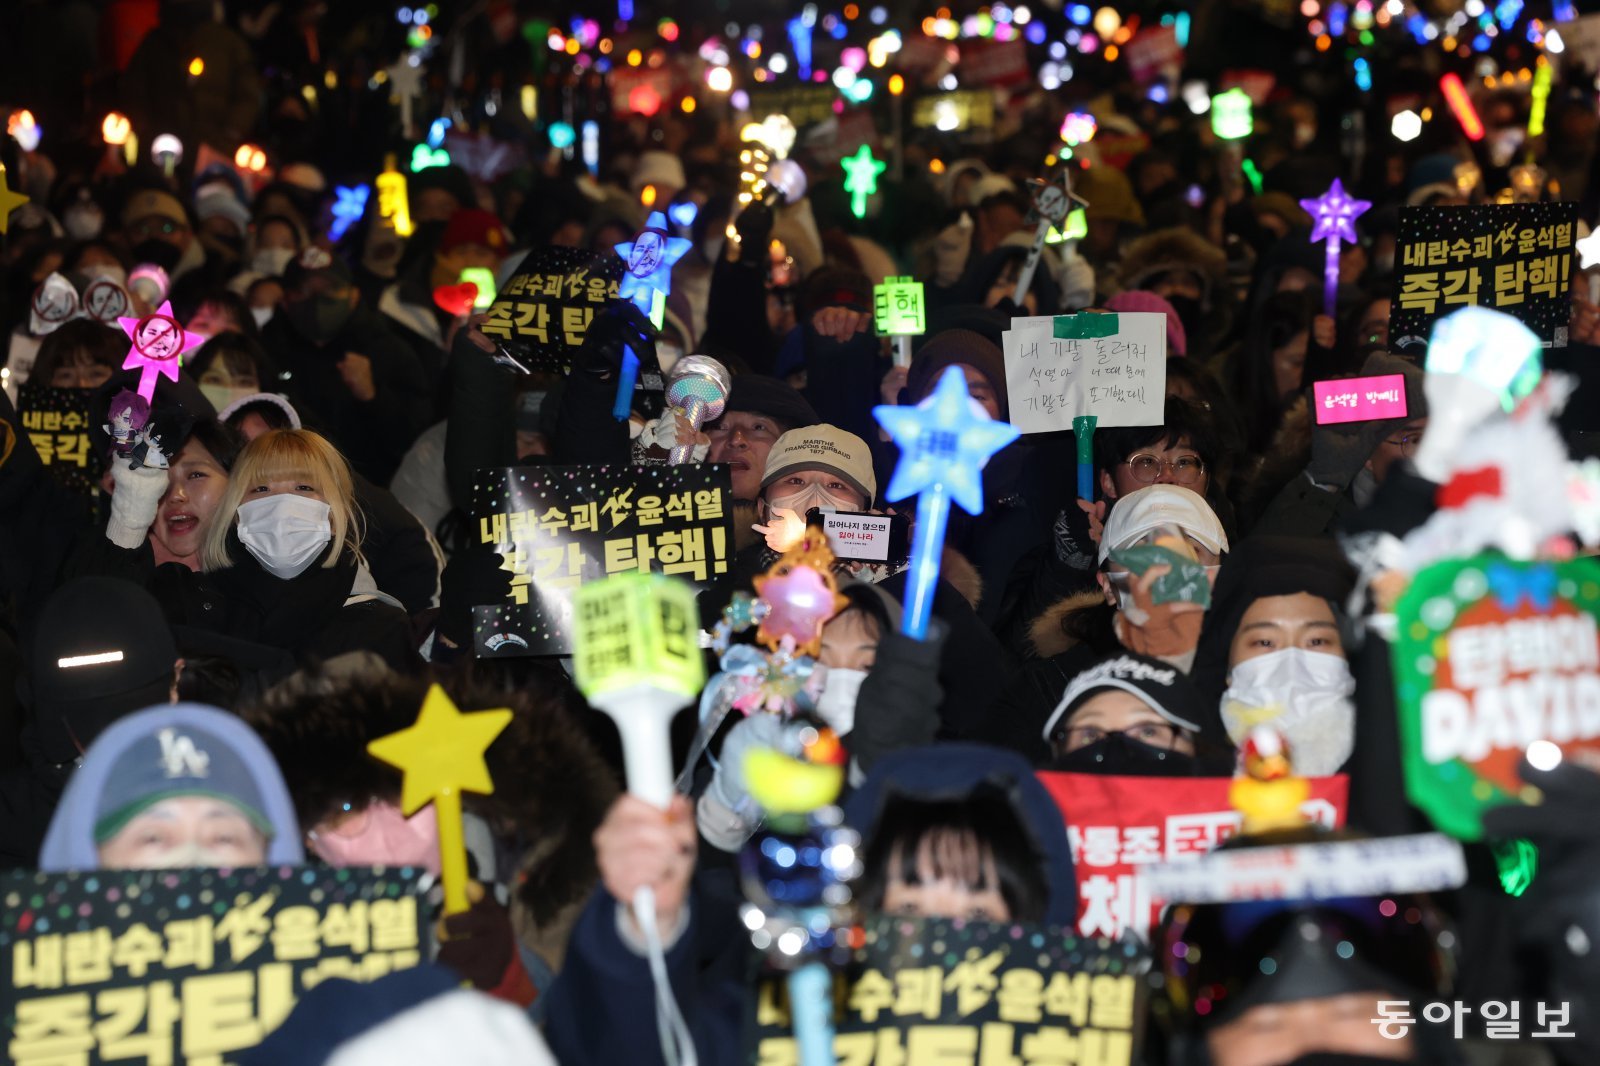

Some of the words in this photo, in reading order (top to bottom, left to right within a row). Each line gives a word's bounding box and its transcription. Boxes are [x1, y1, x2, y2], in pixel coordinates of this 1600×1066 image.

[1403, 233, 1493, 267] 내란수괴
[1517, 221, 1572, 255] 윤석열
[1398, 266, 1483, 315] 즉각
[1494, 253, 1571, 307] 탄핵!
[481, 301, 551, 345] 즉각
[1020, 341, 1039, 360] 내
[1093, 339, 1147, 365] 돌려줘
[22, 410, 89, 431] 내란수
[479, 501, 600, 544] 내란수괴
[635, 487, 724, 527] 윤석열
[828, 520, 860, 530] 일어나지
[862, 523, 887, 532] 않으면
[857, 532, 875, 541] 나라
[12, 914, 215, 989] 내란수괴
[271, 895, 419, 961] 윤석열
[996, 966, 1135, 1028] 윤석열
